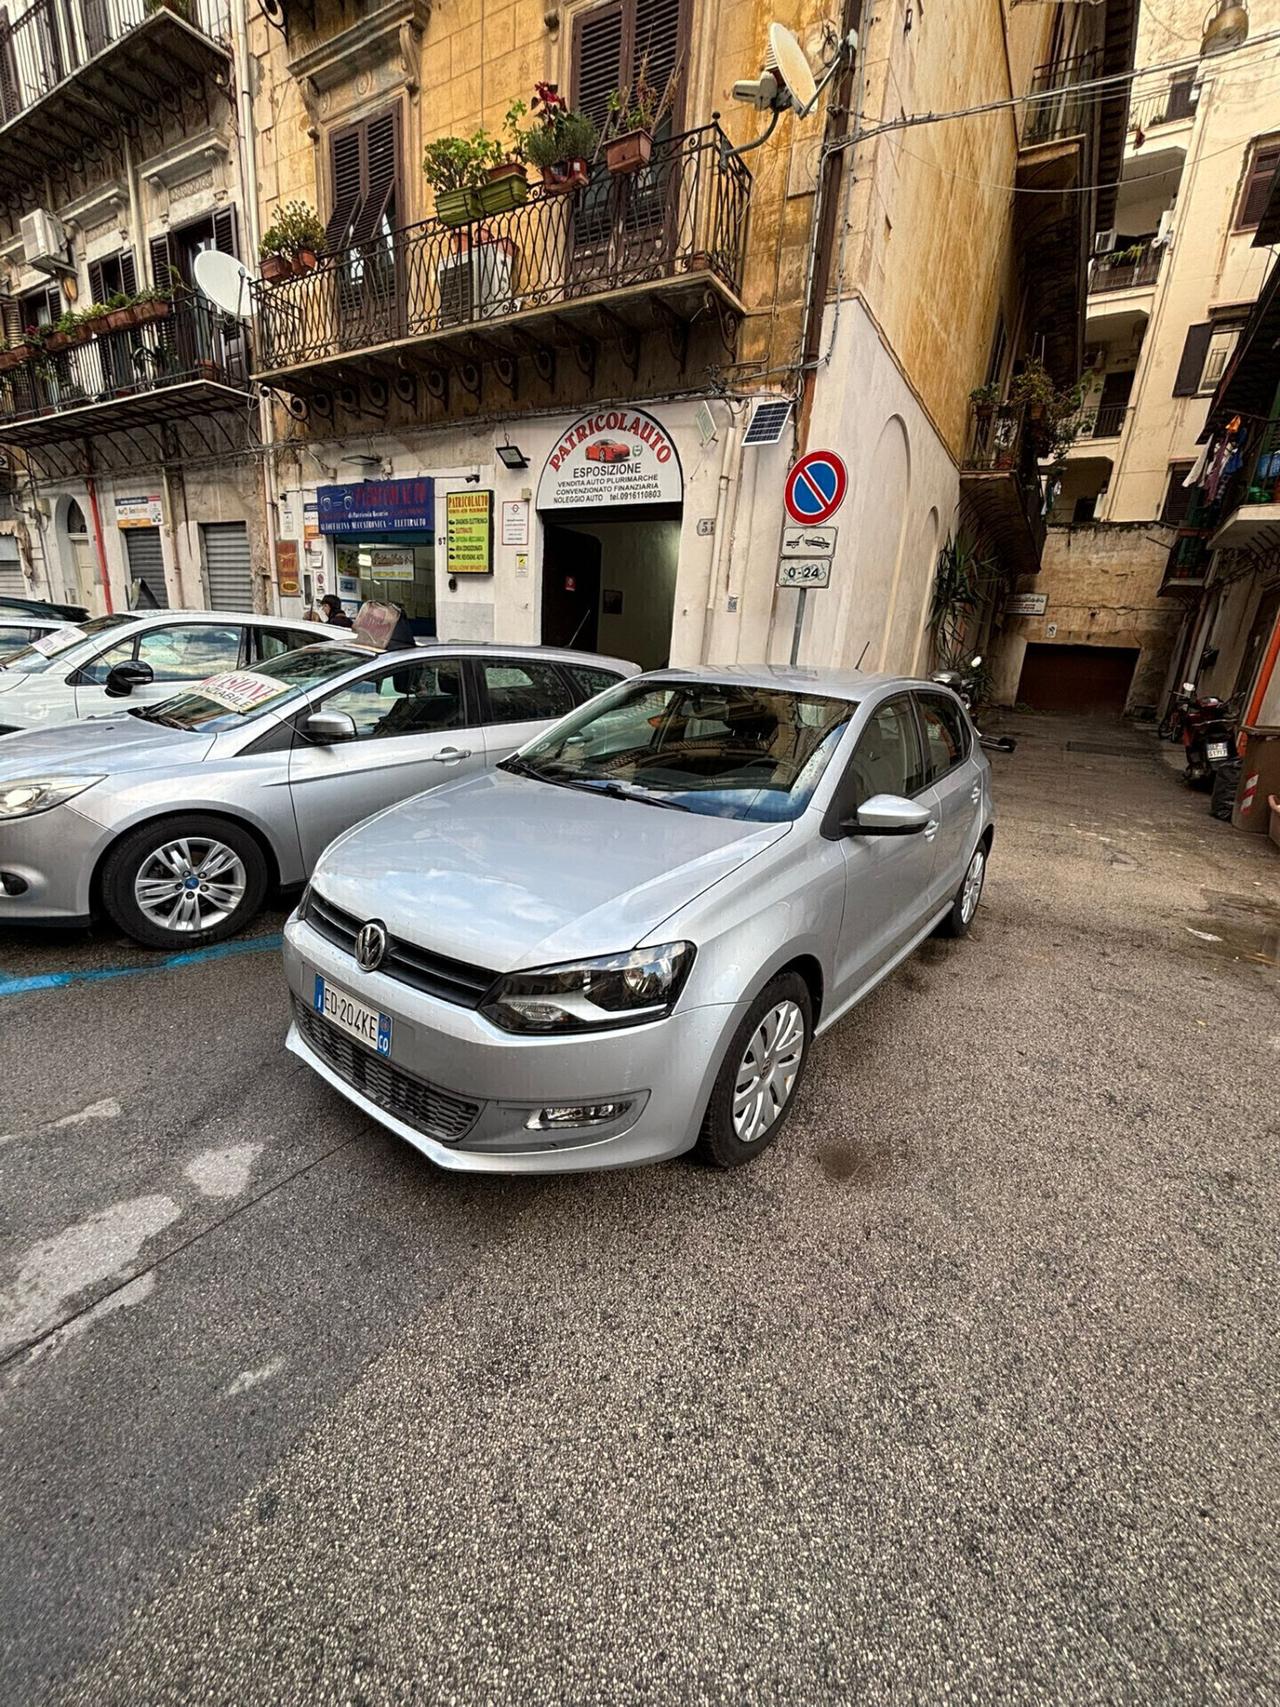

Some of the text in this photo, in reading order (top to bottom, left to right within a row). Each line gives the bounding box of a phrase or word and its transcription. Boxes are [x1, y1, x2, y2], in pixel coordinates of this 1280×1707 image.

[548, 412, 672, 472] PATRICOLAUTO
[573, 462, 642, 479] ESPOSIZIONE
[557, 474, 658, 488] VENDITA AUTO PLURIMARCHE
[555, 482, 659, 496] CONVENZIONATO FINANZIARIA
[553, 495, 586, 504] NOLEGGIO
[586, 494, 604, 502] AUTO
[378, 1035, 389, 1052] CO
